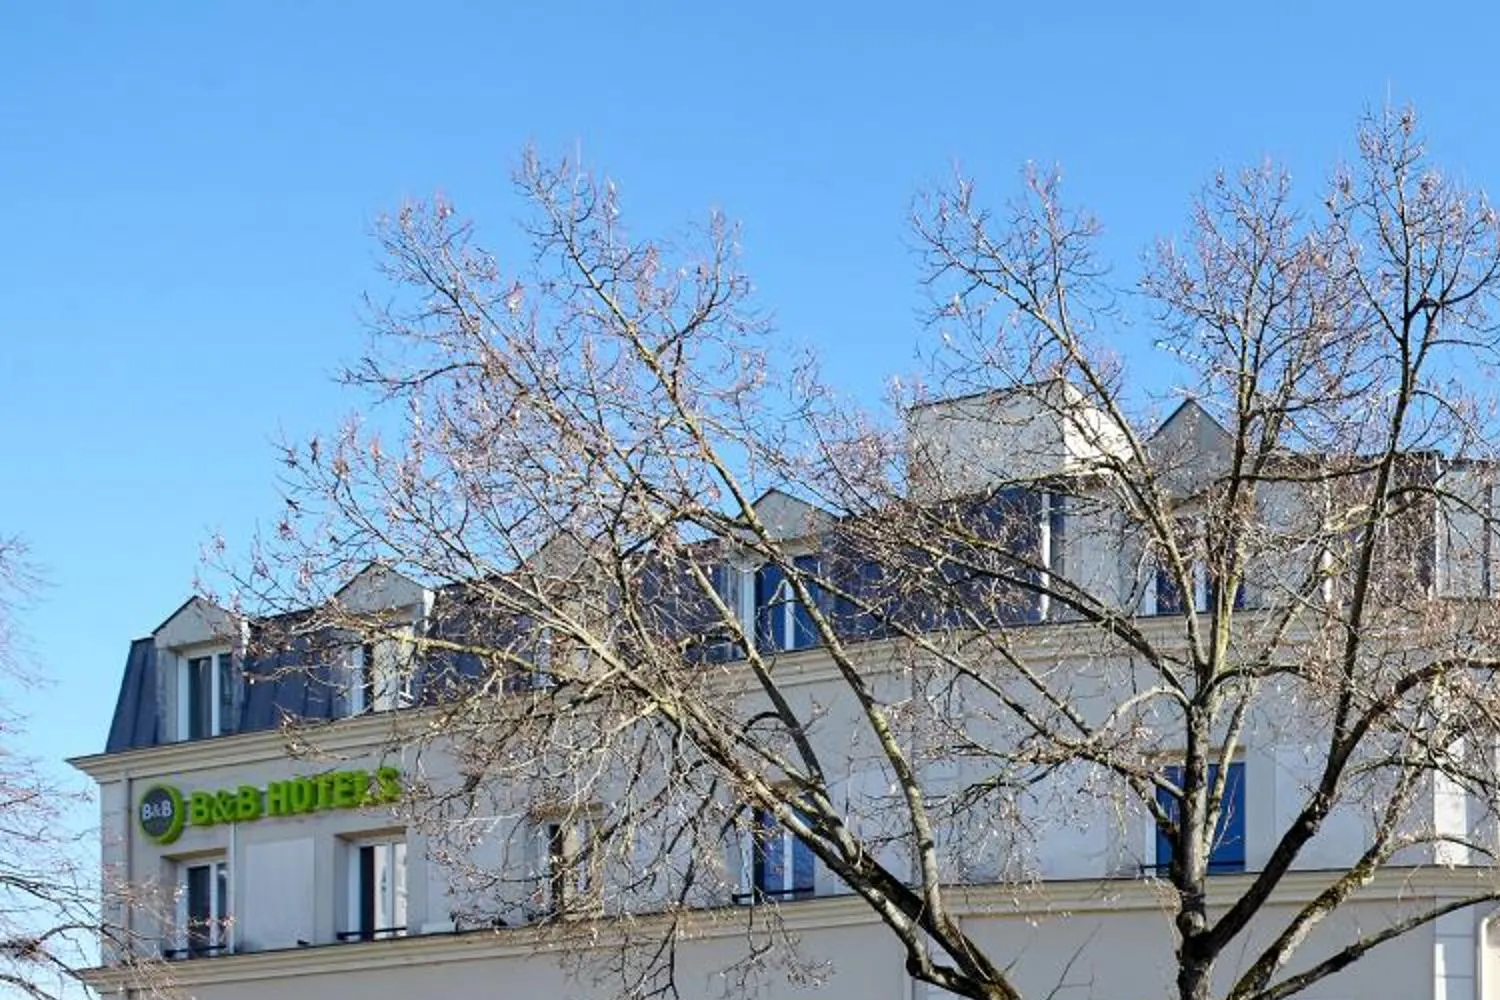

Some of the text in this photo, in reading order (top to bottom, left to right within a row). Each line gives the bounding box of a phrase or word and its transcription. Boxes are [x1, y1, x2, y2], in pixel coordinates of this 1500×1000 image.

[142, 800, 172, 820] B&B
[192, 767, 400, 825] B&B HOTELS
